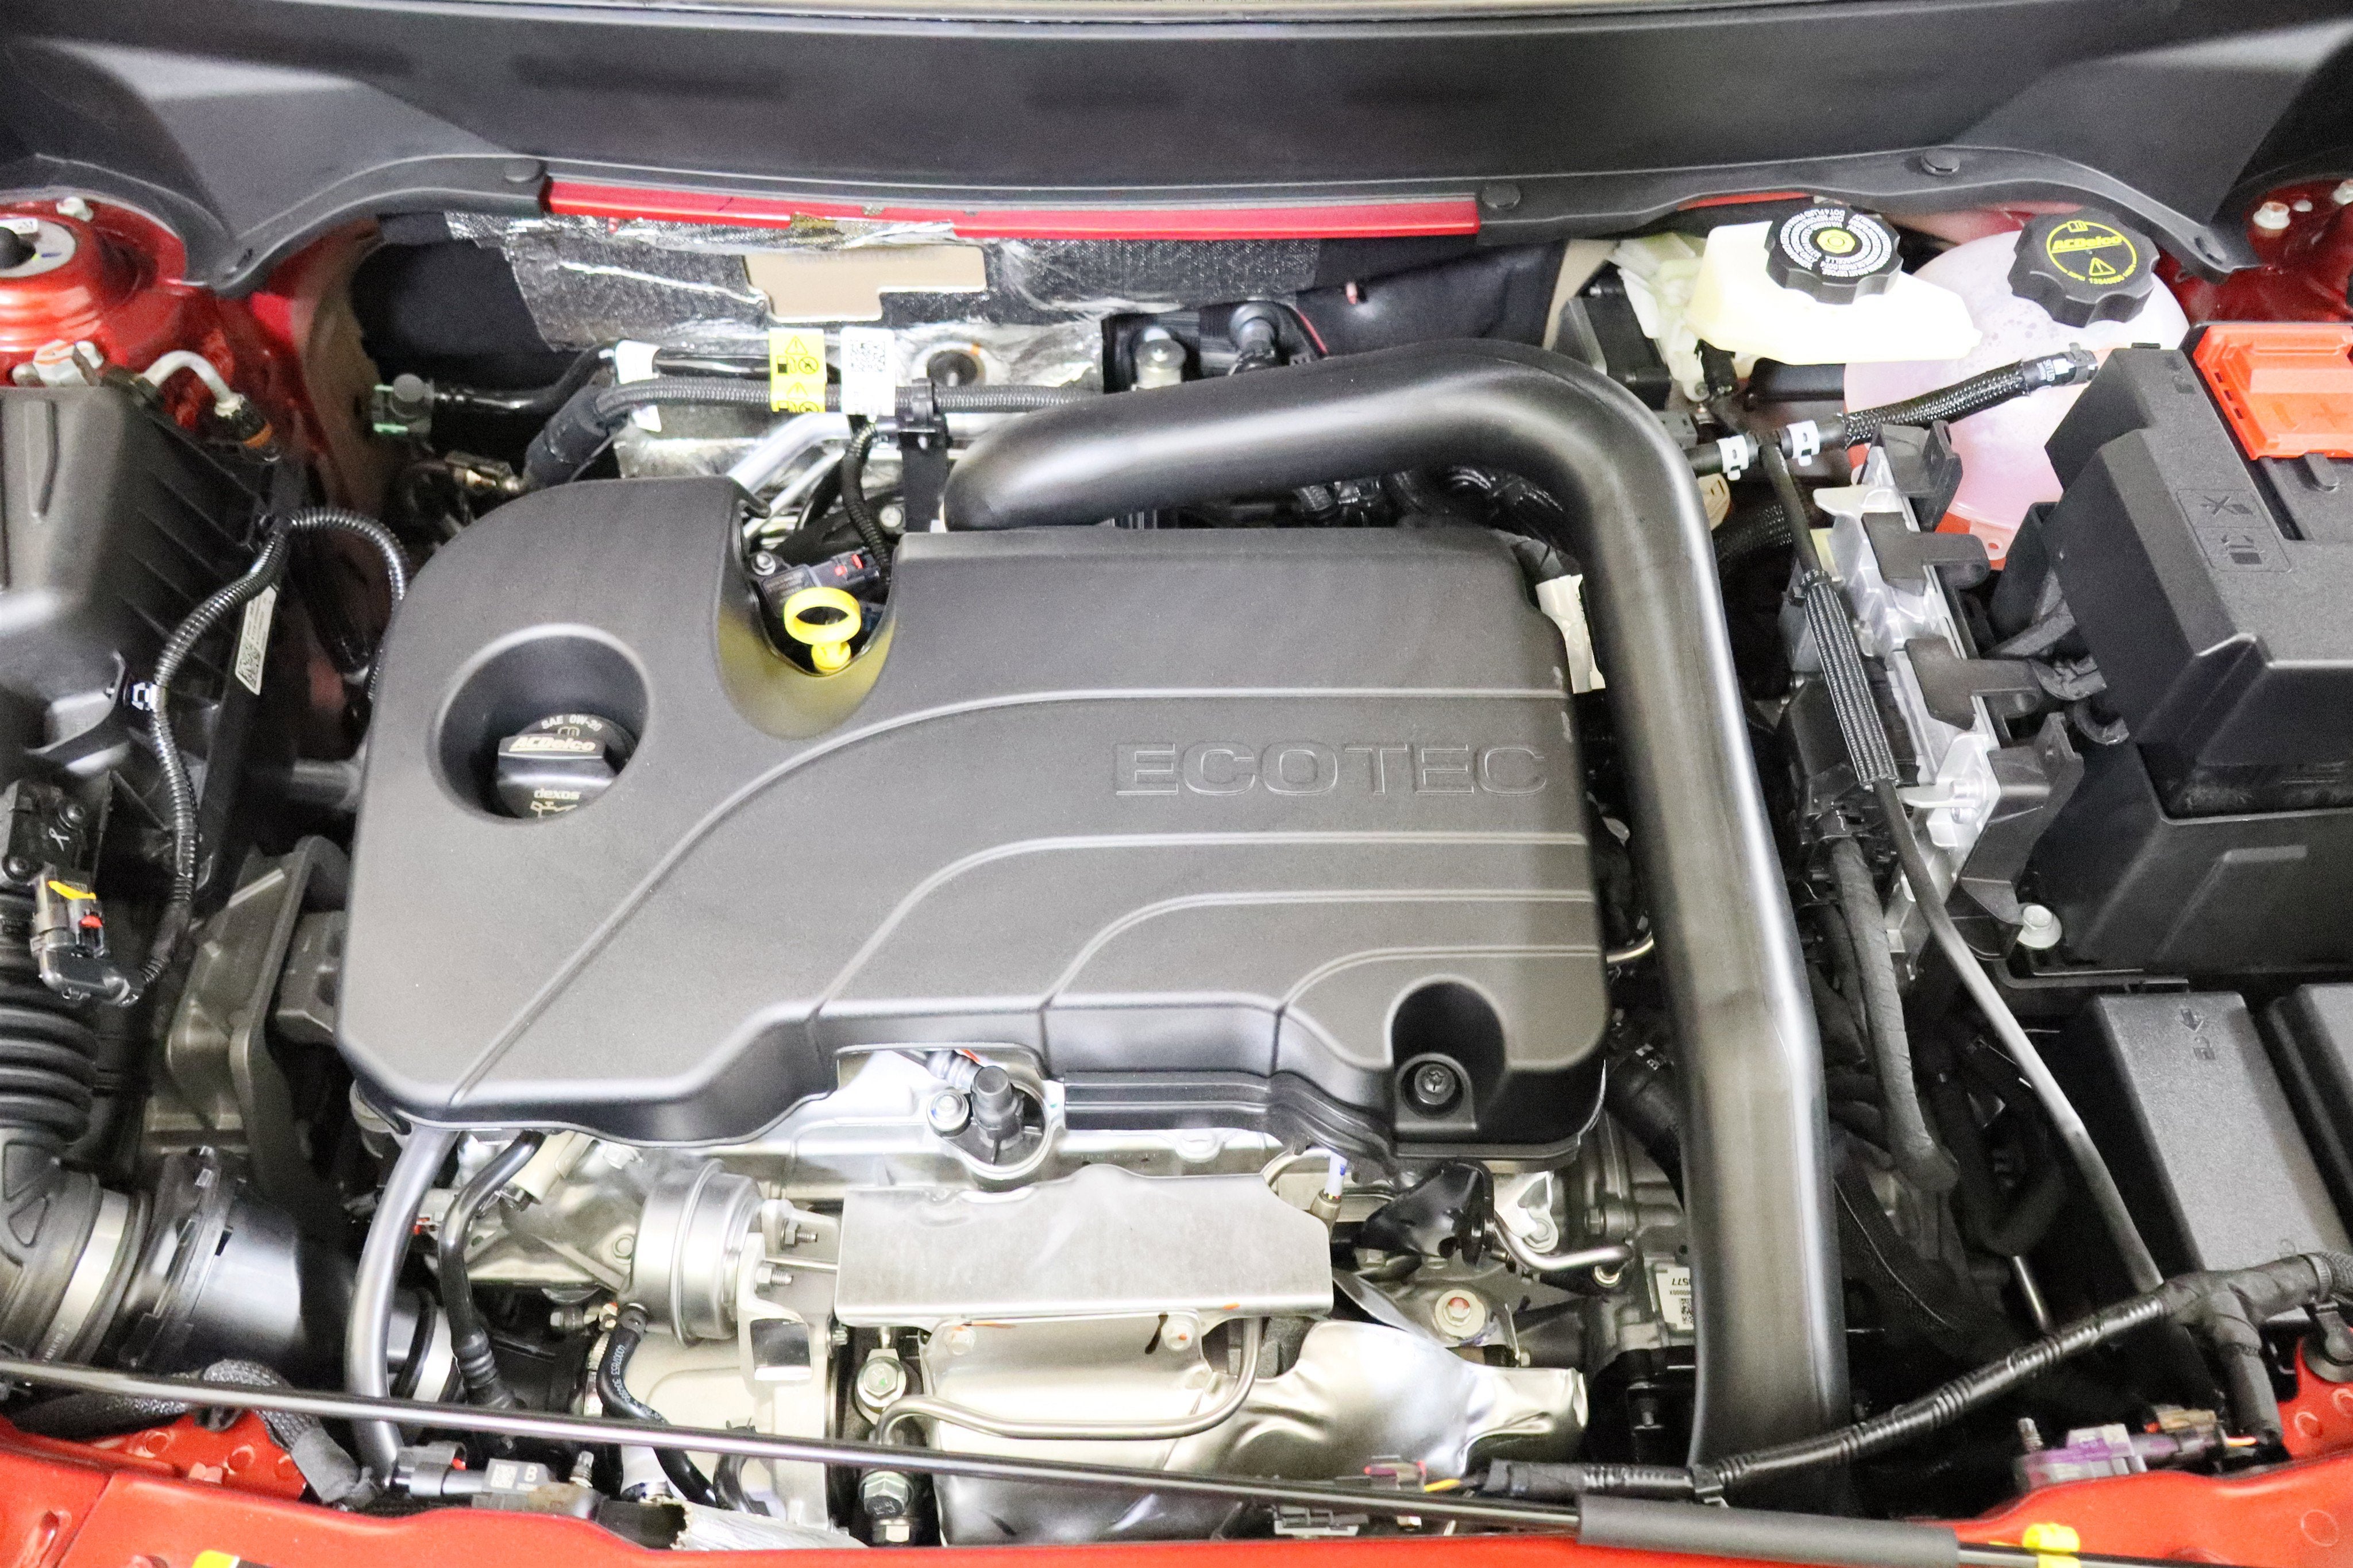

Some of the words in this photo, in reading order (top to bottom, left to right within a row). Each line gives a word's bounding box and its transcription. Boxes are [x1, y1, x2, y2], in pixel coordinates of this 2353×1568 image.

[1804, 209, 1825, 218] FLUID
[2053, 236, 2123, 249] ACDelco
[541, 716, 564, 729] SAE
[569, 715, 603, 732] 0W-20
[510, 736, 596, 752] ACDelco
[1116, 742, 1547, 795] ECOTEC
[534, 788, 581, 800] dexos
